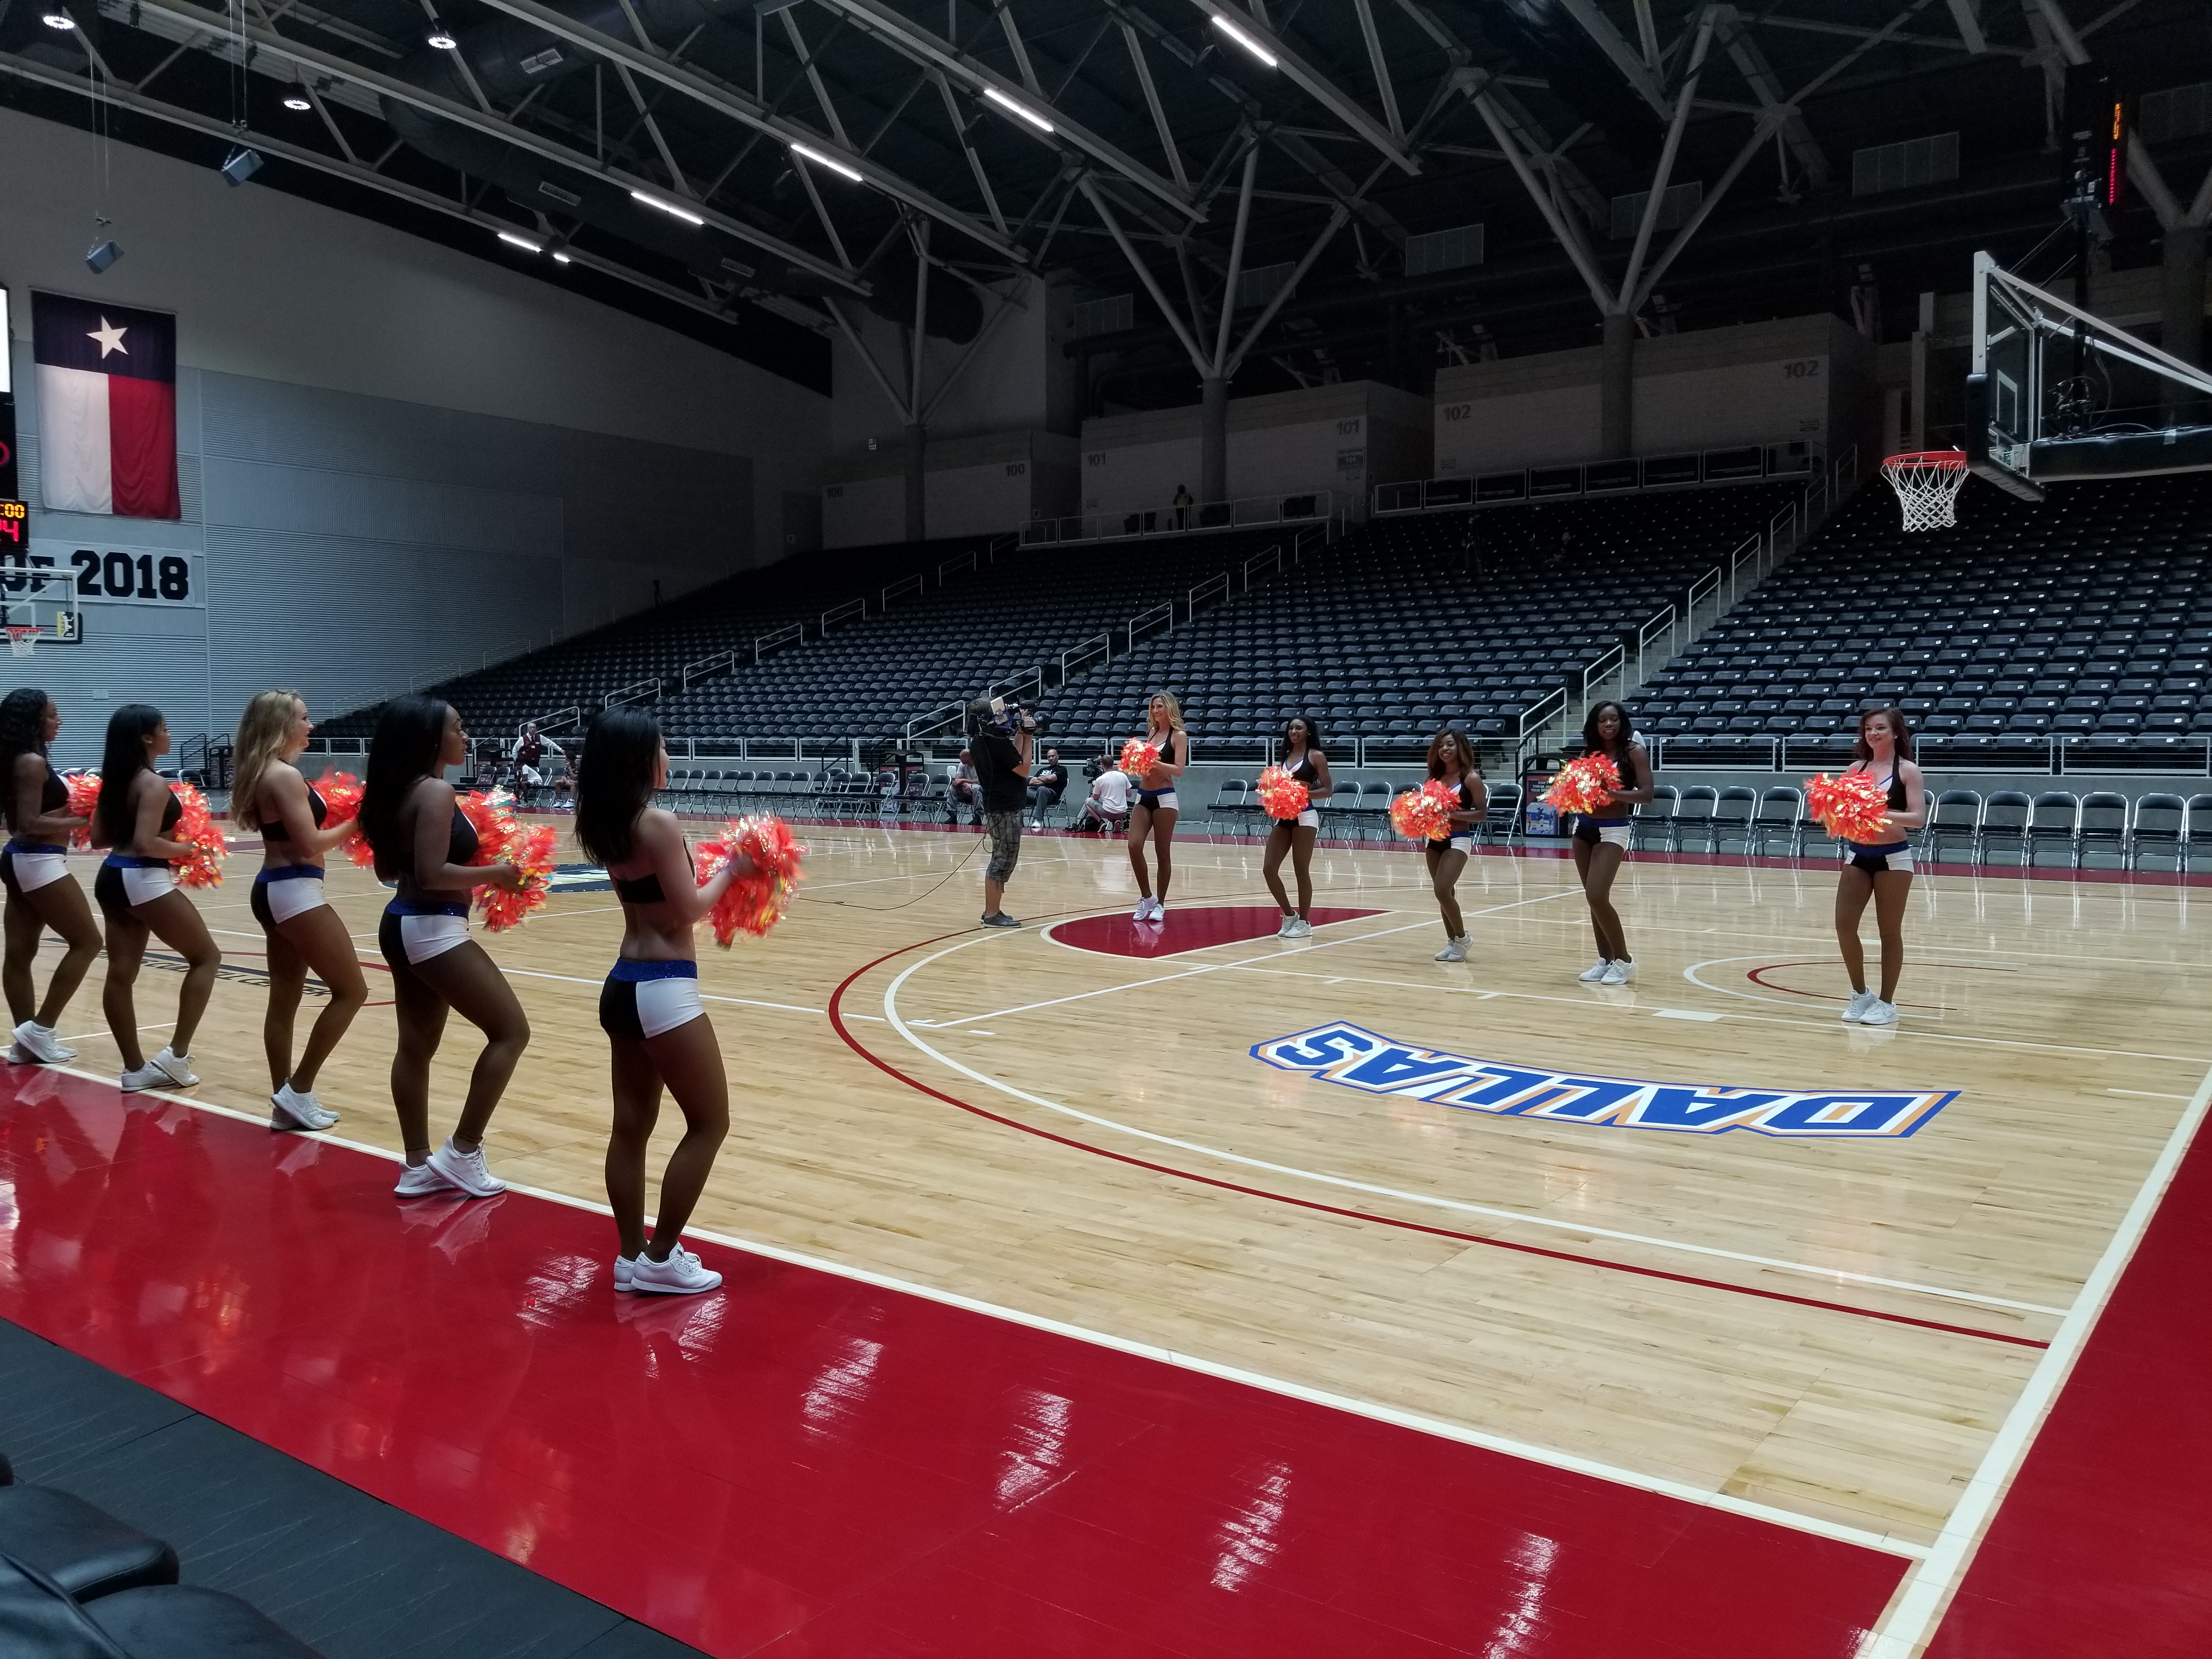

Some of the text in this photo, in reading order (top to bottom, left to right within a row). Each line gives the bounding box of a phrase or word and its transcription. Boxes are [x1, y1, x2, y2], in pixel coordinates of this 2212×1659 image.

[1784, 359, 1818, 378] 102
[1443, 404, 1471, 421] 102
[1337, 419, 1359, 435] 101
[1087, 452, 1106, 467] 101
[1006, 464, 1025, 477] 100
[827, 486, 843, 498] 100
[0, 519, 19, 542] 4
[71, 550, 189, 601] 2018
[1249, 1020, 1962, 1138] DALLAS
